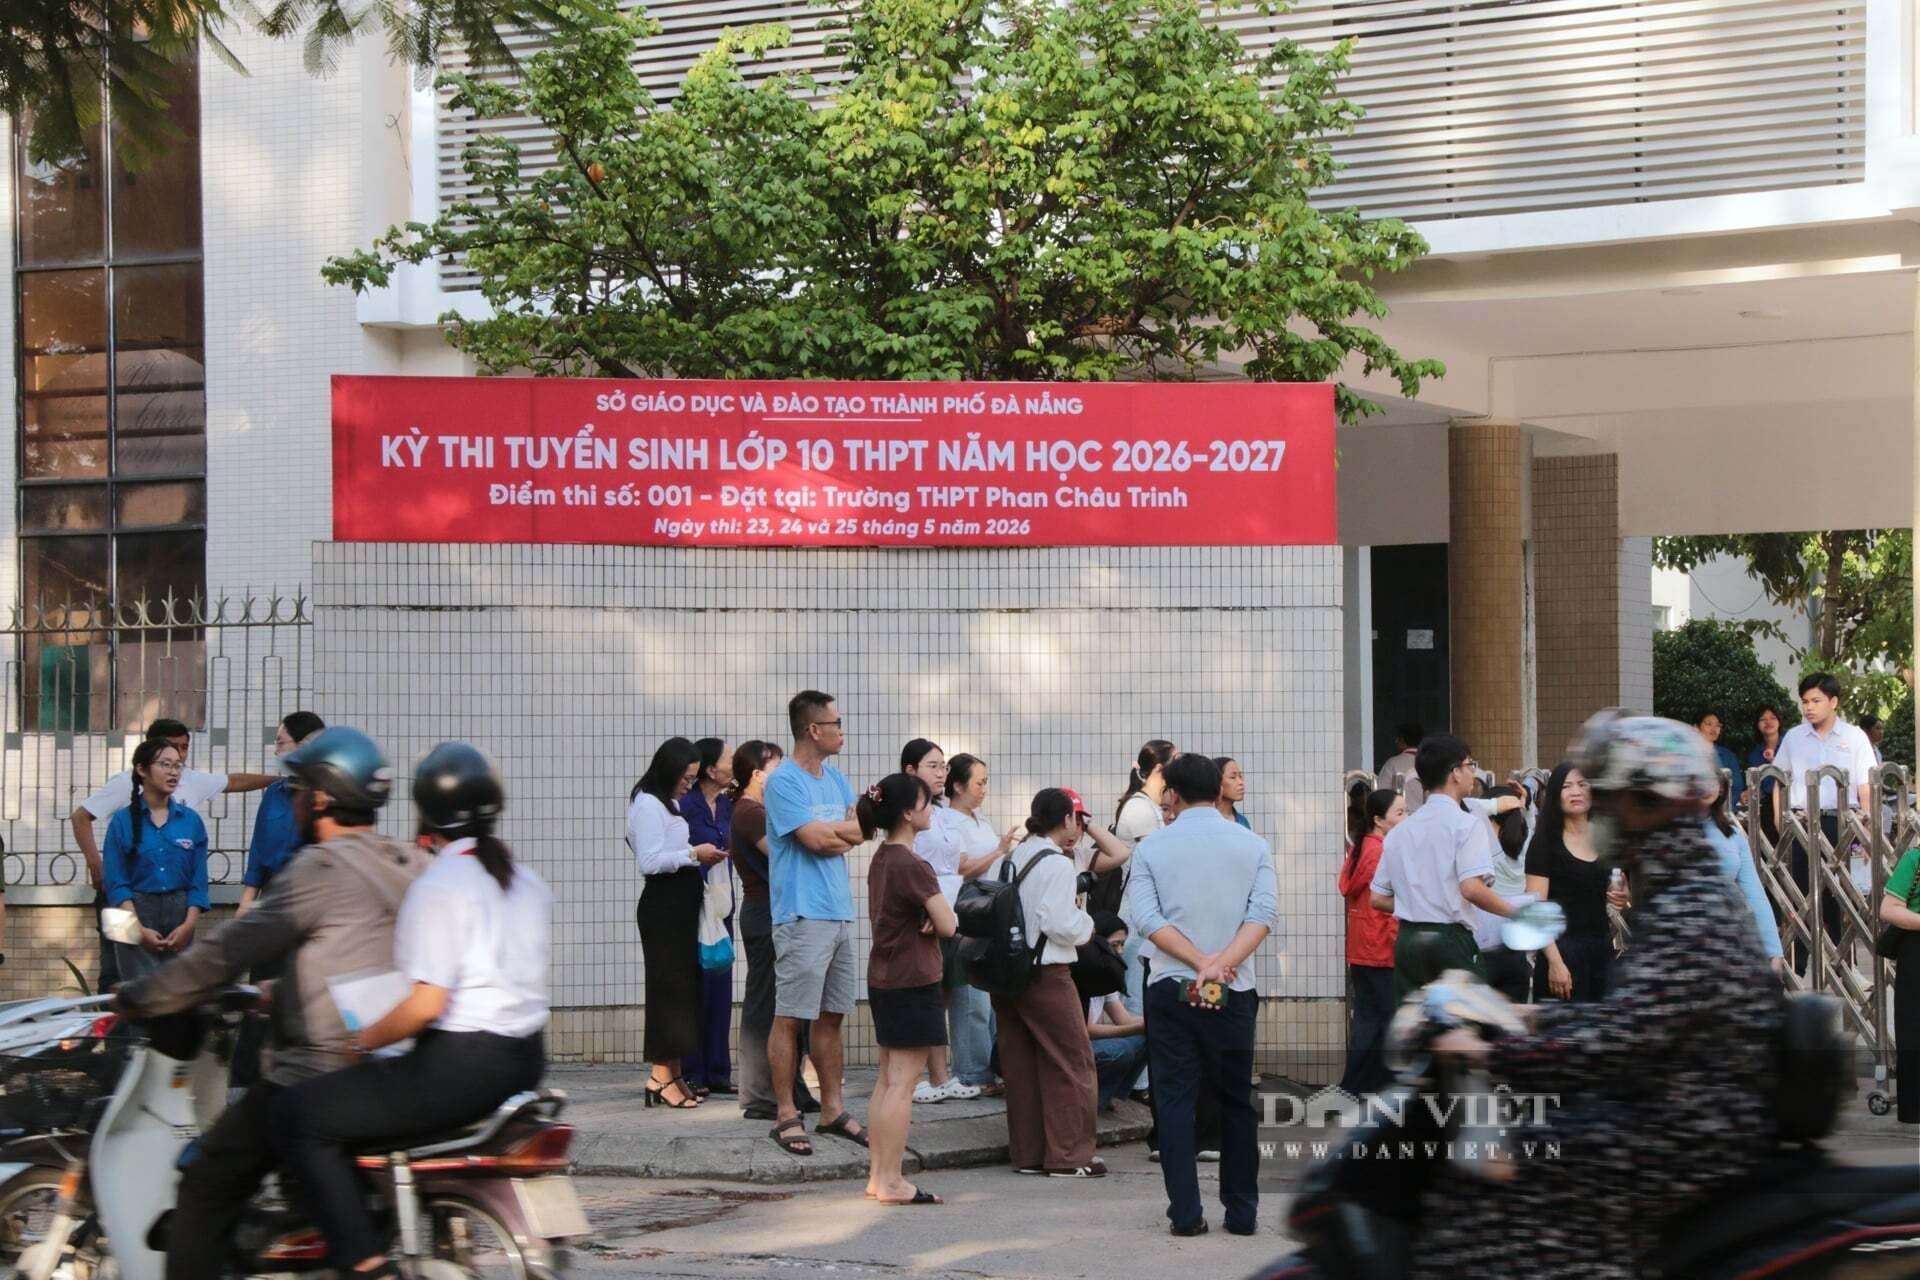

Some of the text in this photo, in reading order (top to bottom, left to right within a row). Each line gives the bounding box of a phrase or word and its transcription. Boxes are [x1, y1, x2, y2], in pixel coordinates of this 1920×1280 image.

[597, 390, 1084, 418] SỞ GIÁO DỤC VÀ ĐÀO TẠO THÀNH PHỐ ĐÀ NẴNG
[381, 423, 1286, 482] KỲ THI TUYỂN SINH LỚP 10 THPT NĂM HỌC 2026-2027
[489, 480, 556, 506] Điểm
[561, 484, 597, 506] thi
[604, 482, 641, 507] số:
[648, 484, 692, 507] 001
[720, 485, 767, 513] Đặt
[774, 486, 817, 513] tại:
[823, 486, 911, 513] Trường
[917, 487, 980, 508] THPT
[985, 487, 1049, 508] Phan
[1055, 486, 1121, 508] Châu
[1127, 487, 1188, 508] Trinh
[654, 517, 1031, 539] Ngày thi: 23, 24 và 25 tháng 5 năm 2026
